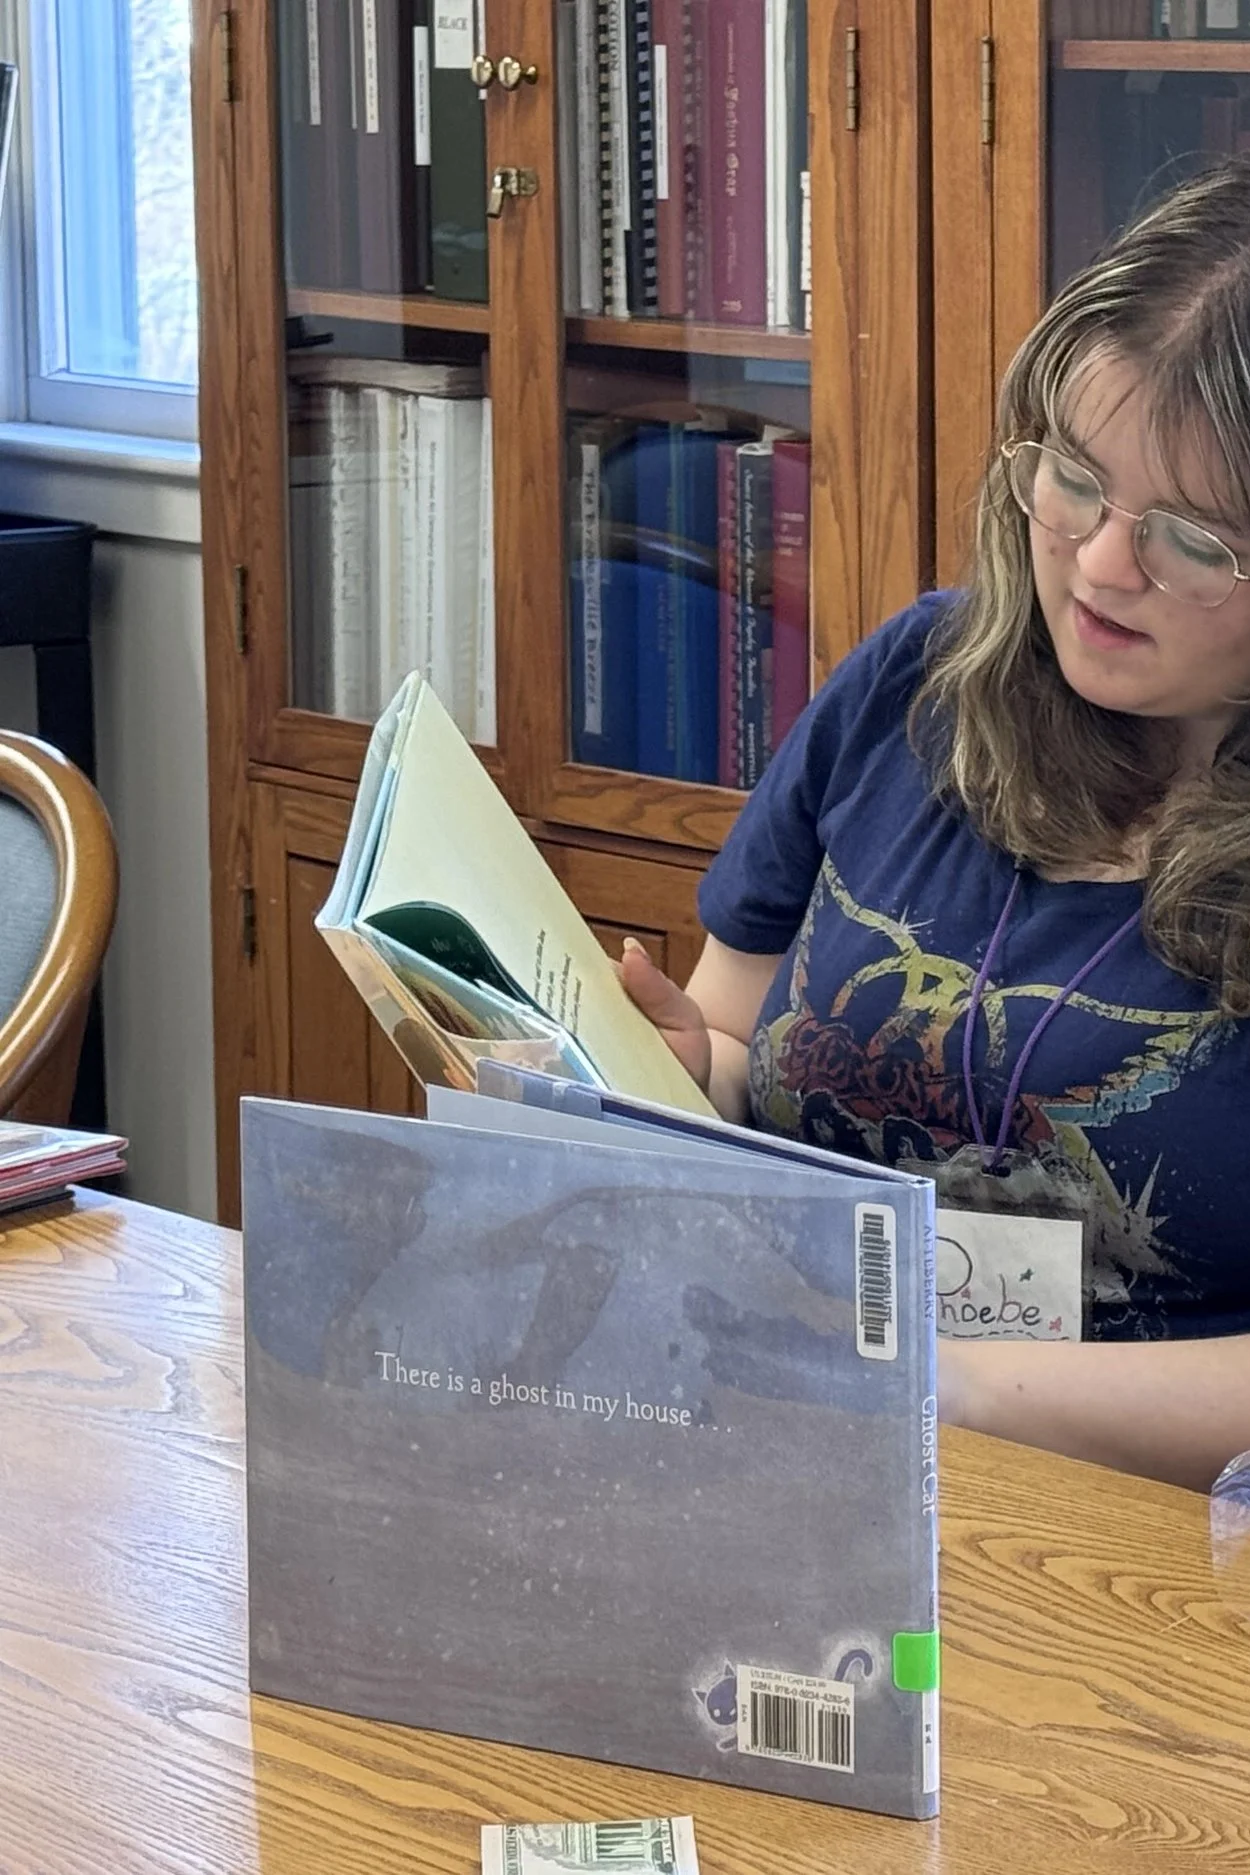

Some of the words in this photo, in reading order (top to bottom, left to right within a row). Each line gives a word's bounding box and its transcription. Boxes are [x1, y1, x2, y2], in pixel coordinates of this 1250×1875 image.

[437, 16, 468, 31] BLACK
[374, 1351, 441, 1389] There
[447, 1367, 464, 1392] is
[470, 1376, 482, 1395] a
[488, 1373, 549, 1406] ghost
[555, 1383, 577, 1410] in
[582, 1394, 620, 1422] my
[625, 1393, 693, 1427] house
[921, 1394, 938, 1469] Ghost
[921, 1471, 938, 1517] Cat
